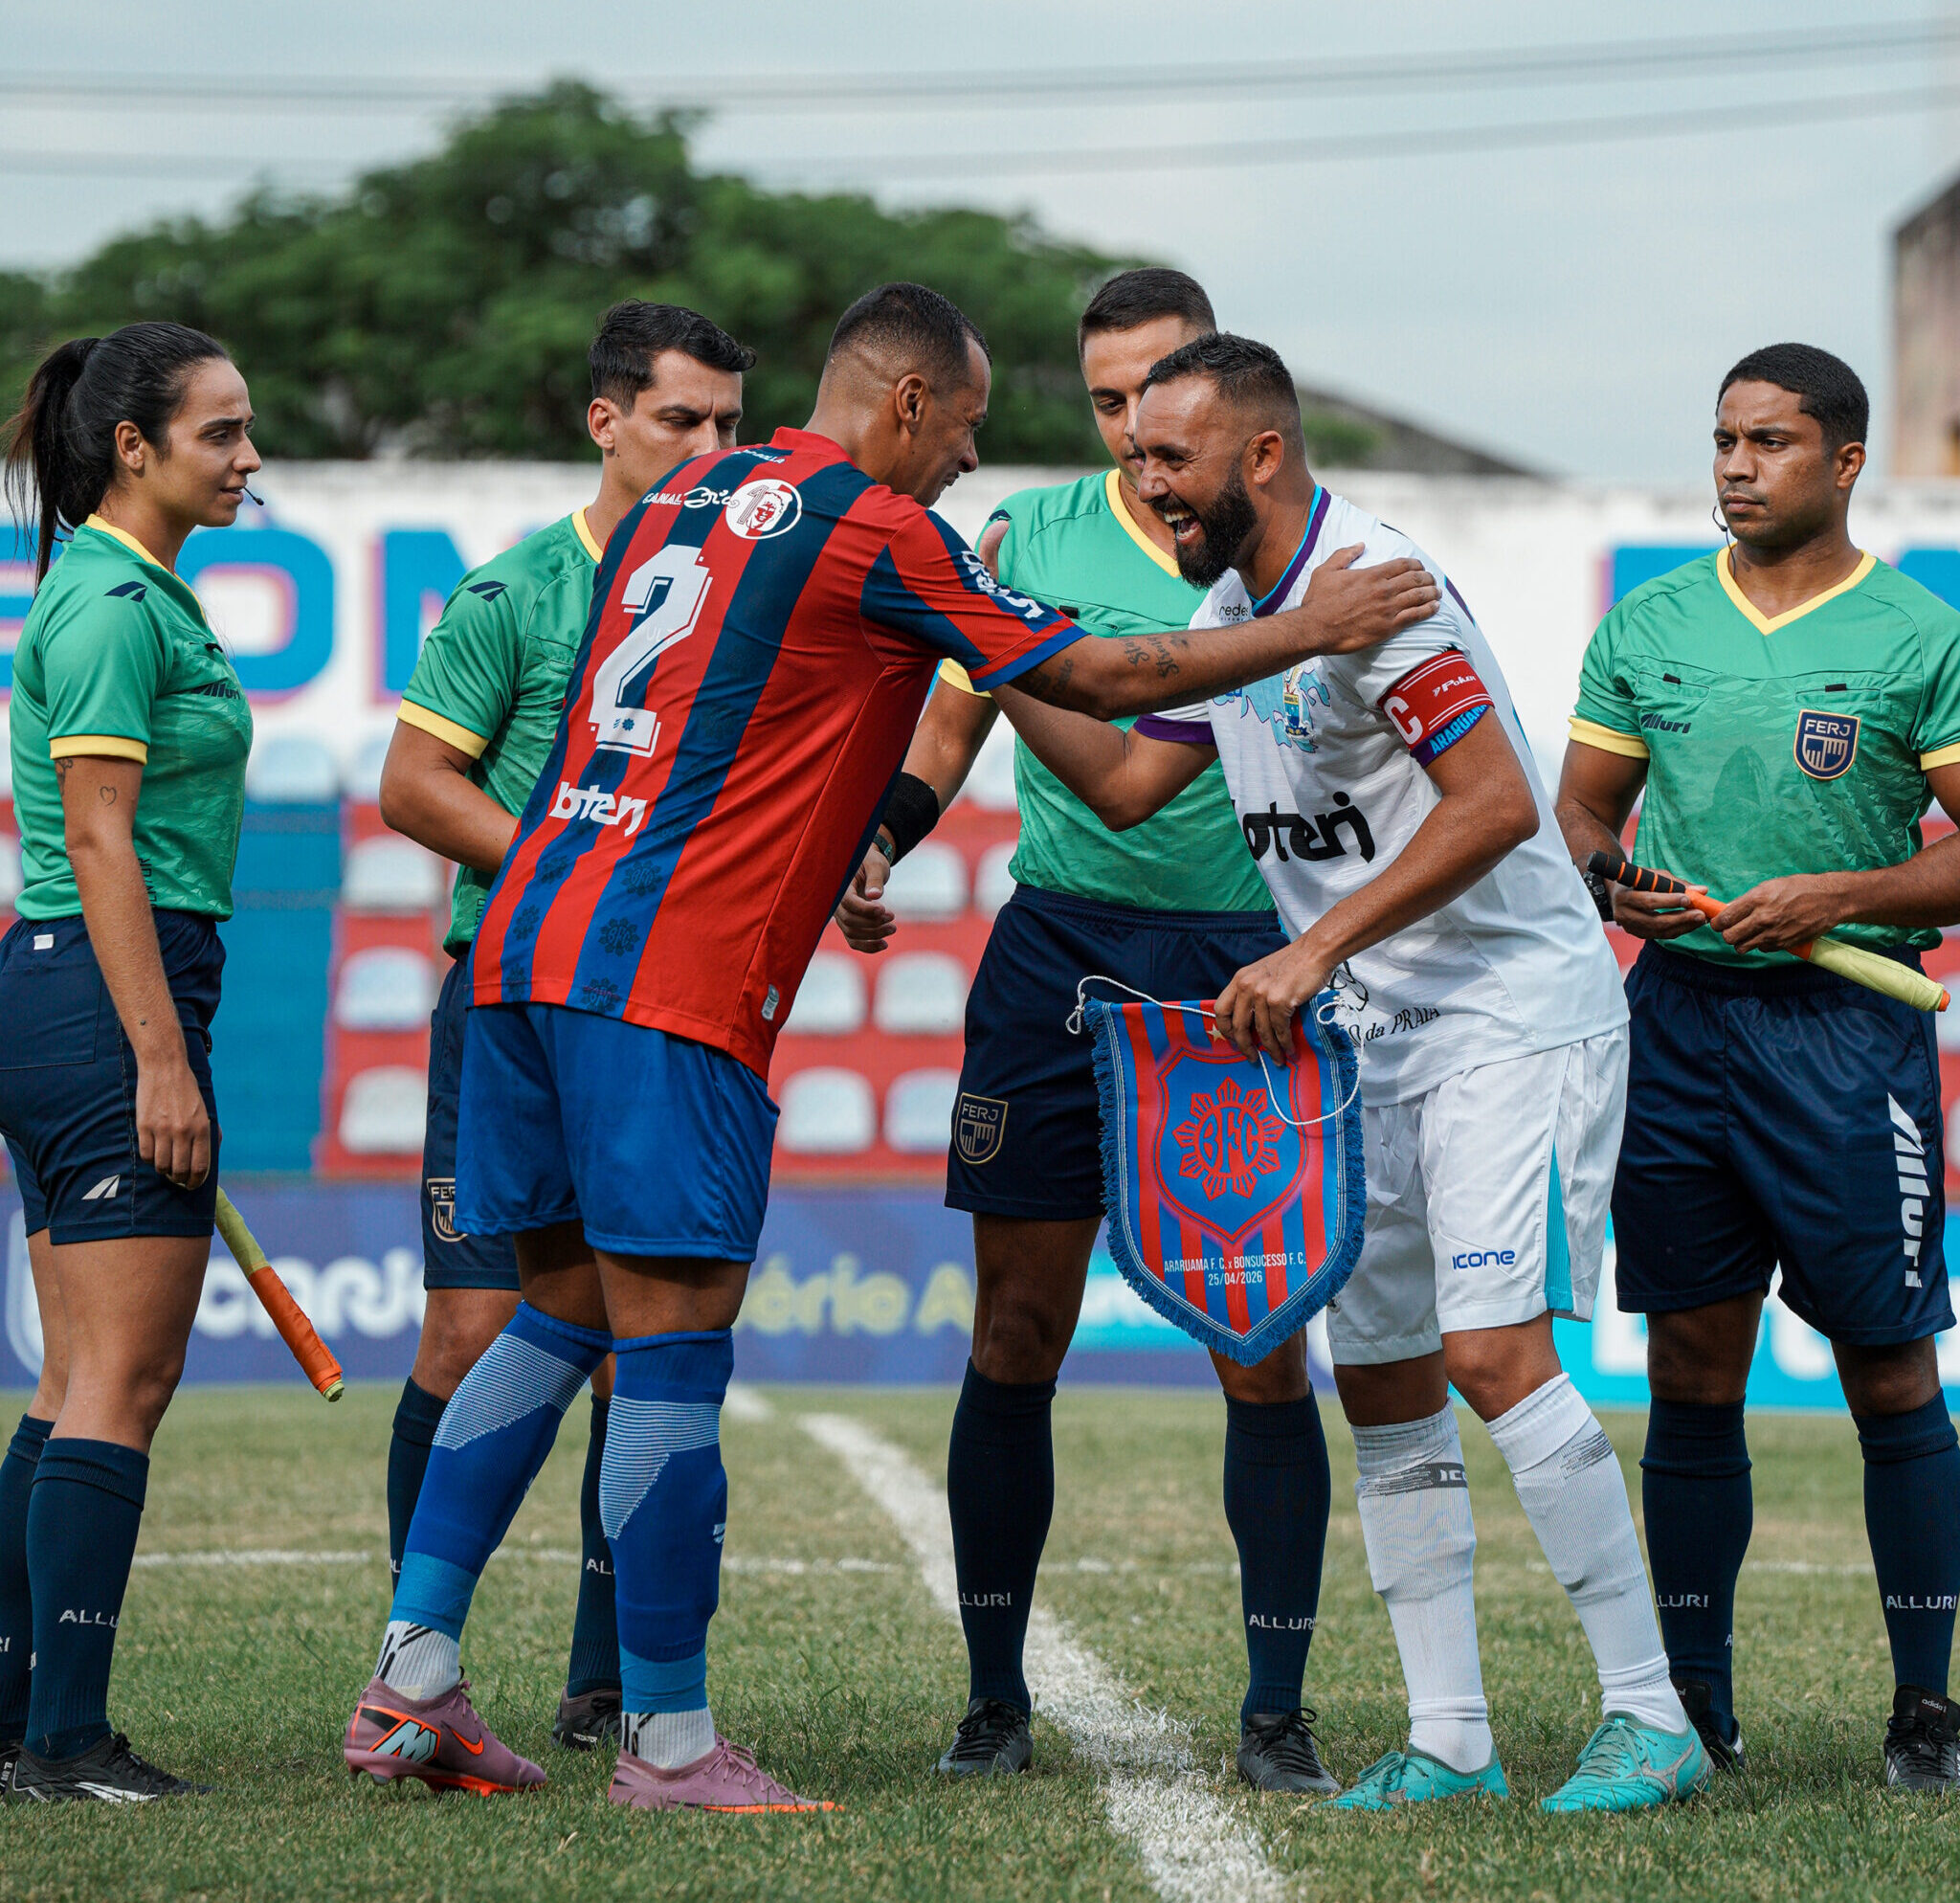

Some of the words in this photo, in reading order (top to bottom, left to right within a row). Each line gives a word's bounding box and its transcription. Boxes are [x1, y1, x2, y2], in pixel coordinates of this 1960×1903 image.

[642, 492, 683, 505] CANAL
[588, 544, 714, 758] 2
[1384, 696, 1423, 745] C
[1804, 719, 1851, 737] FERJ
[1391, 1007, 1441, 1036] PRAIA
[961, 1103, 999, 1122] FERJ
[431, 1186, 456, 1199] FER
[1164, 1259, 1209, 1272] ARARUAMA
[1234, 1254, 1287, 1269] BONSUCESSO
[1208, 1271, 1263, 1287] 25/04/2026
[586, 1558, 615, 1575] AL
[1657, 1595, 1709, 1608] LURI
[1885, 1595, 1958, 1610] ALLURI
